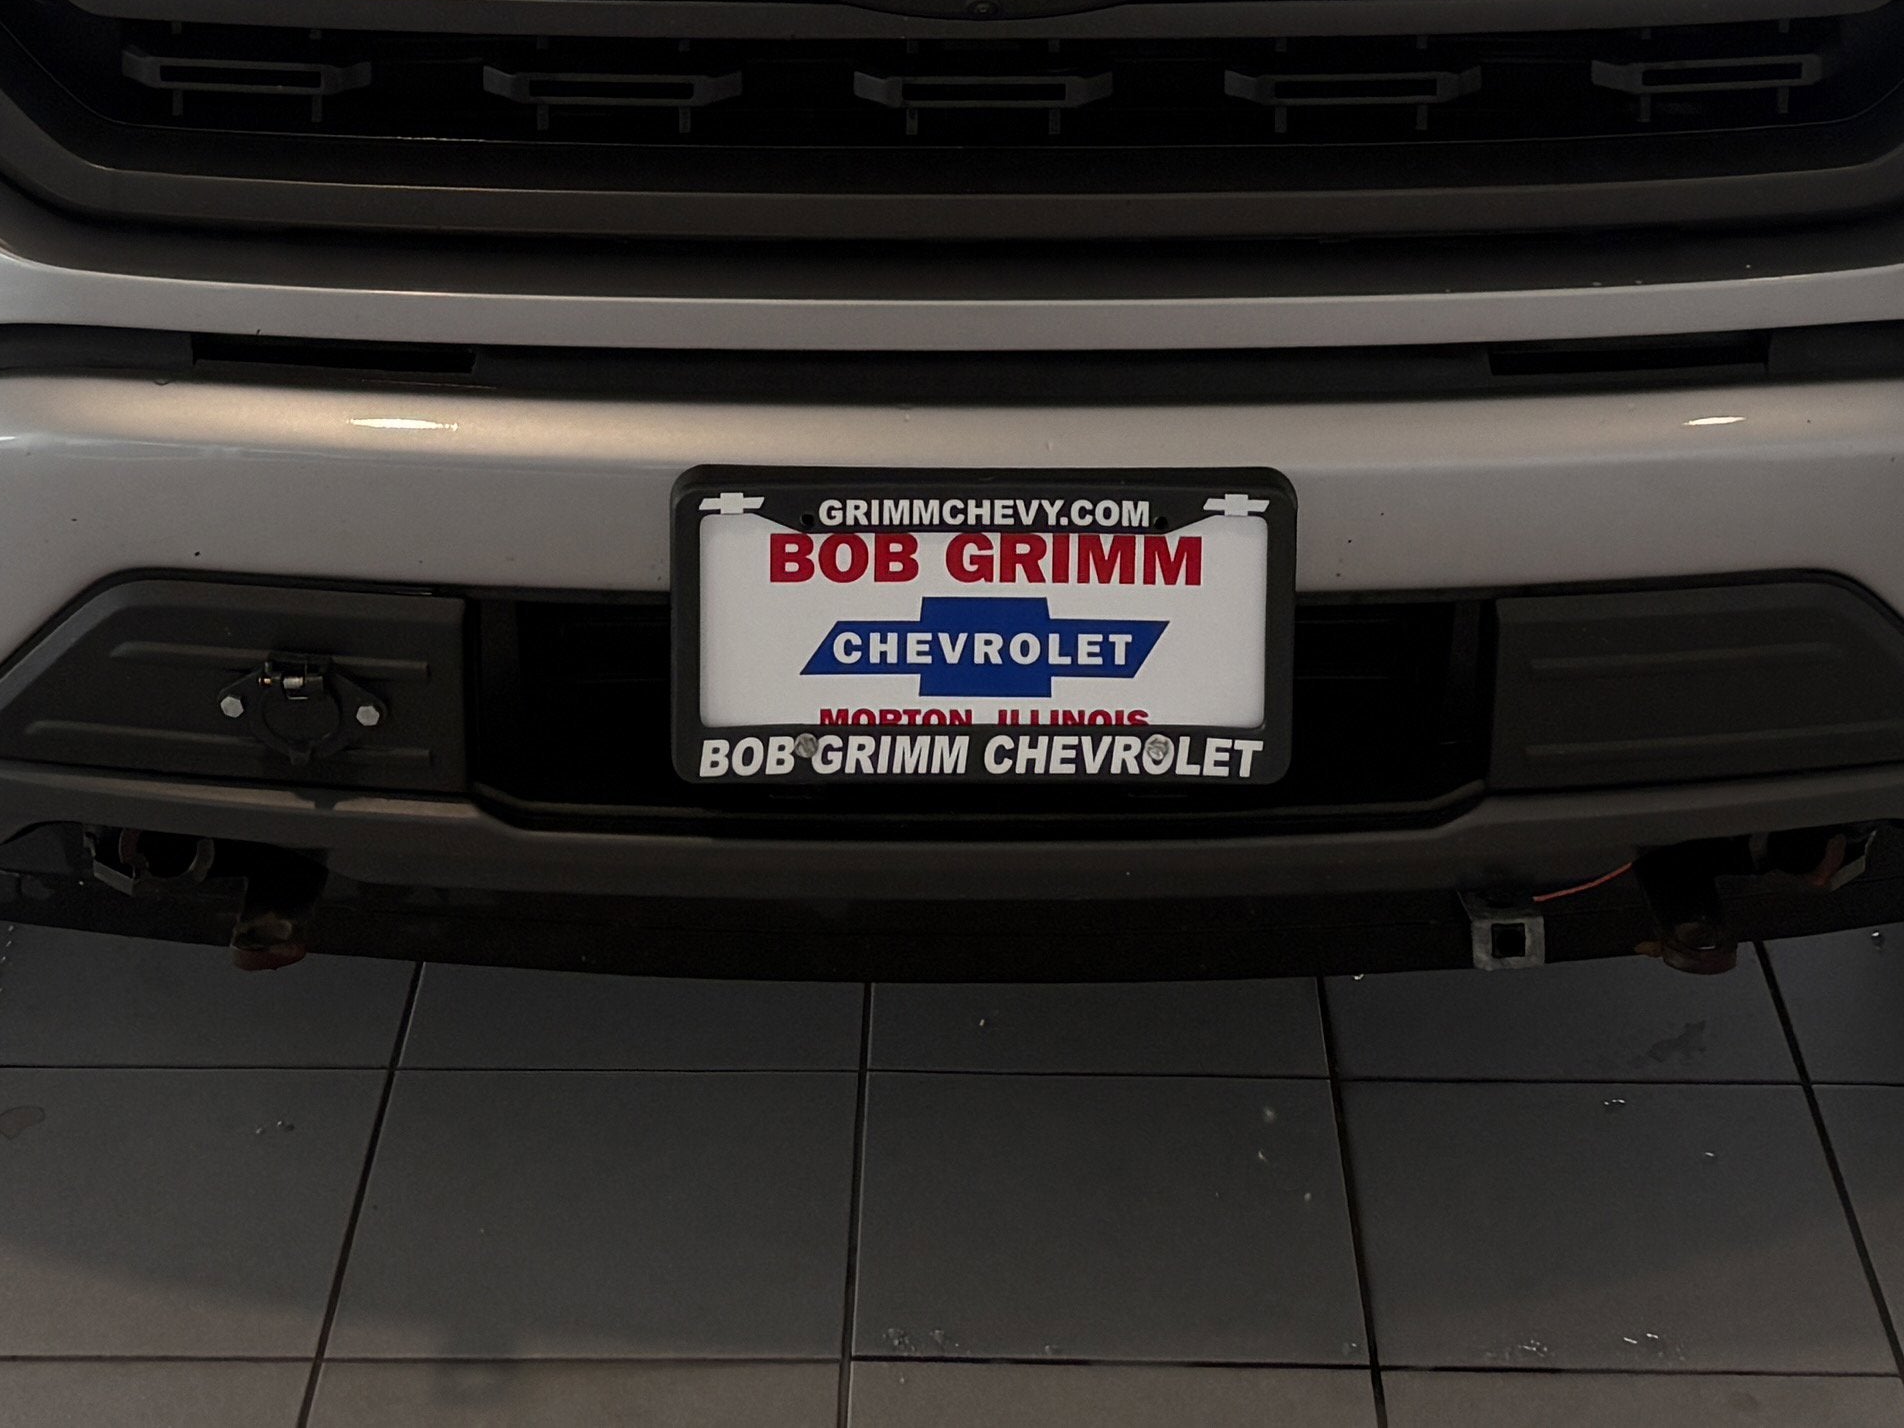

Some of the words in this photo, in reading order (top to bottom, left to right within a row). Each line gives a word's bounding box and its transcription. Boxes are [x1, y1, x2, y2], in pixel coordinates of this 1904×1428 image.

[818, 499, 1150, 528] GRIMMCHEVY.COM
[770, 532, 920, 583] BOB
[945, 532, 1203, 586] GRIMM
[832, 631, 1133, 666] CHEVROLET
[699, 735, 796, 777] BOB
[811, 734, 970, 775] GRIMM
[983, 733, 1264, 778] CHEVROLET
